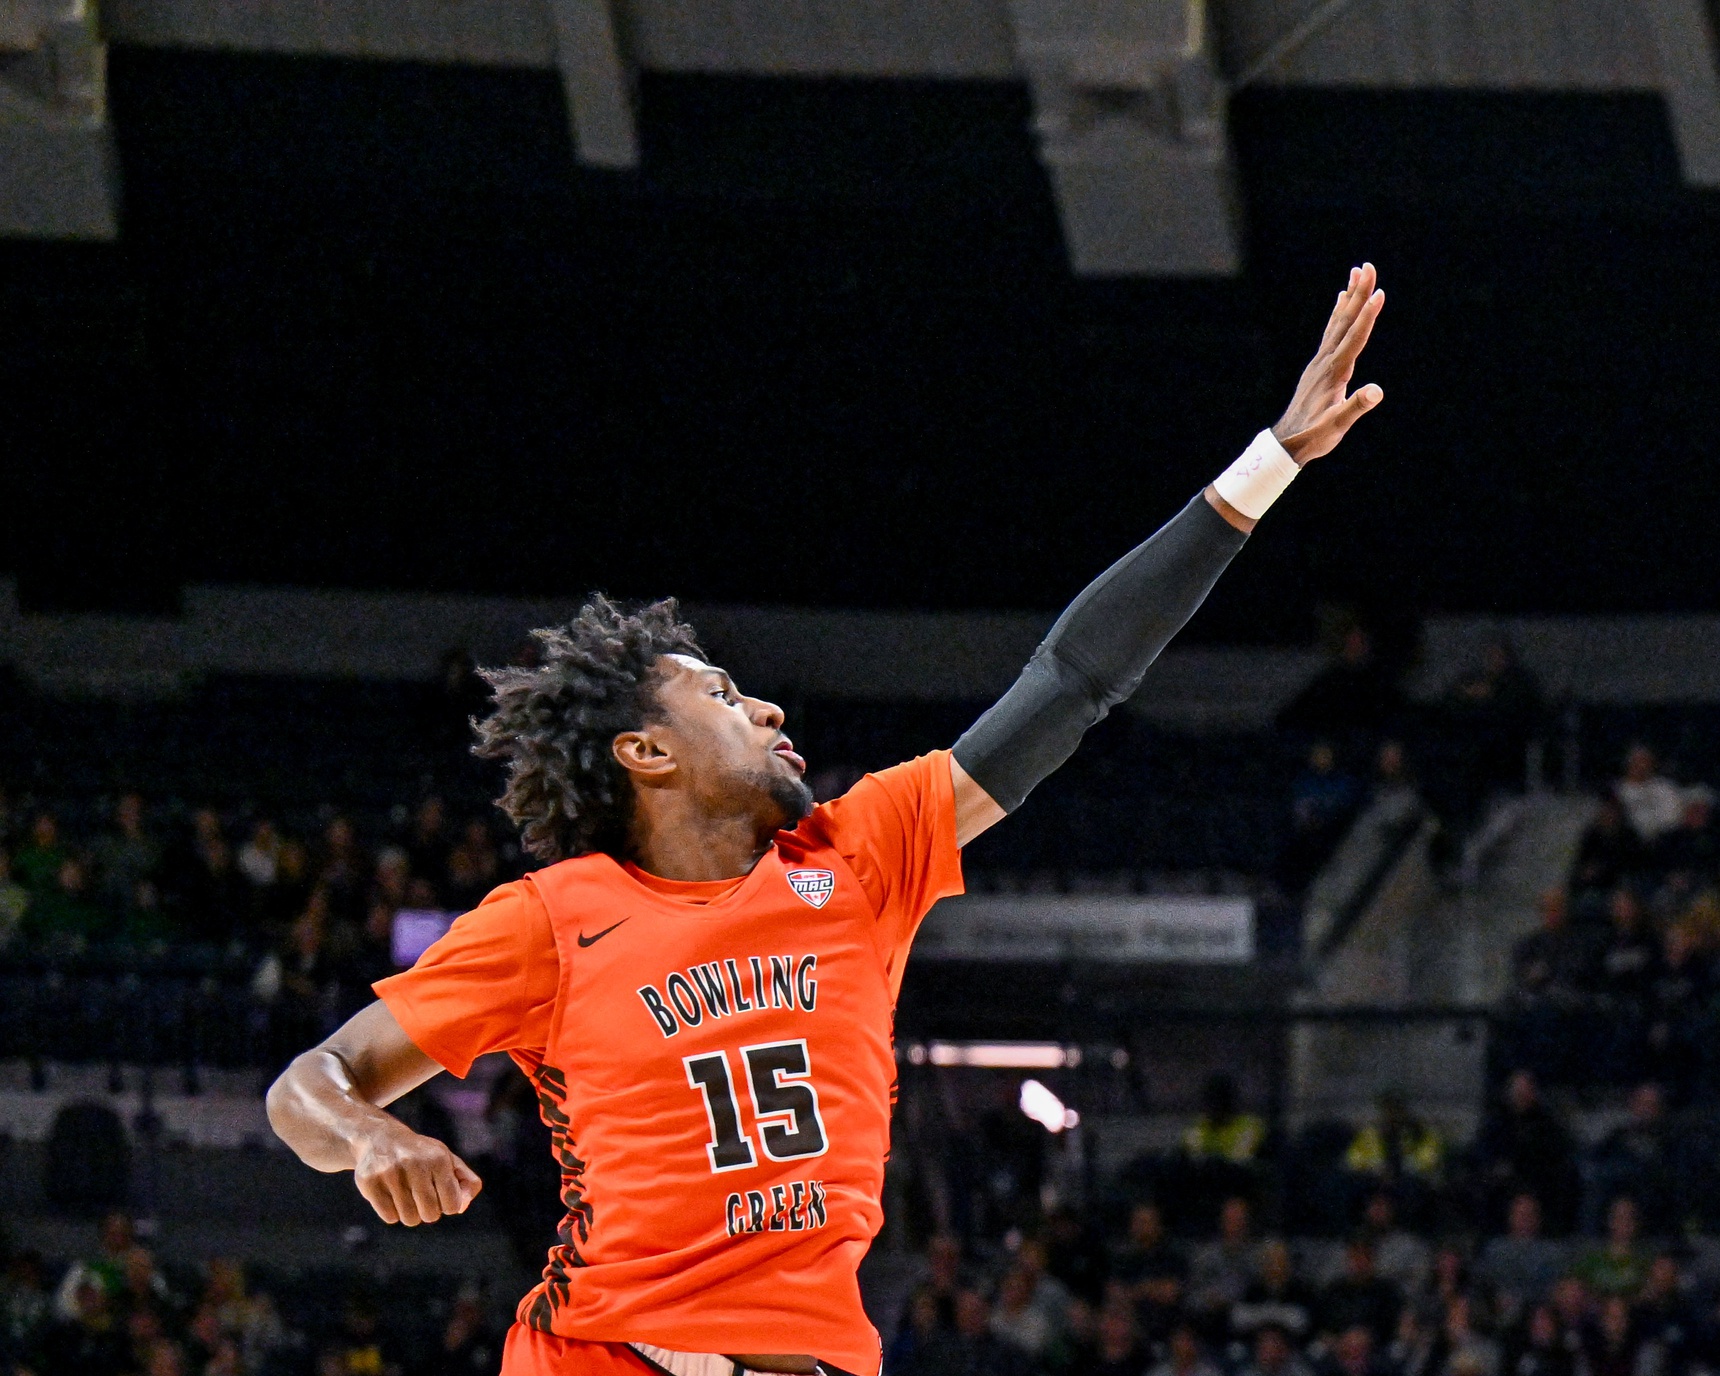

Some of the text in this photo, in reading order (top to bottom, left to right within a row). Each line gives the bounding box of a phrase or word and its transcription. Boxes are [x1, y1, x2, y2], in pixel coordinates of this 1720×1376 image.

[793, 879, 833, 892] MAC
[637, 954, 818, 1038] BOWLING
[682, 1038, 829, 1173] 15
[725, 1180, 827, 1237] GREEN
